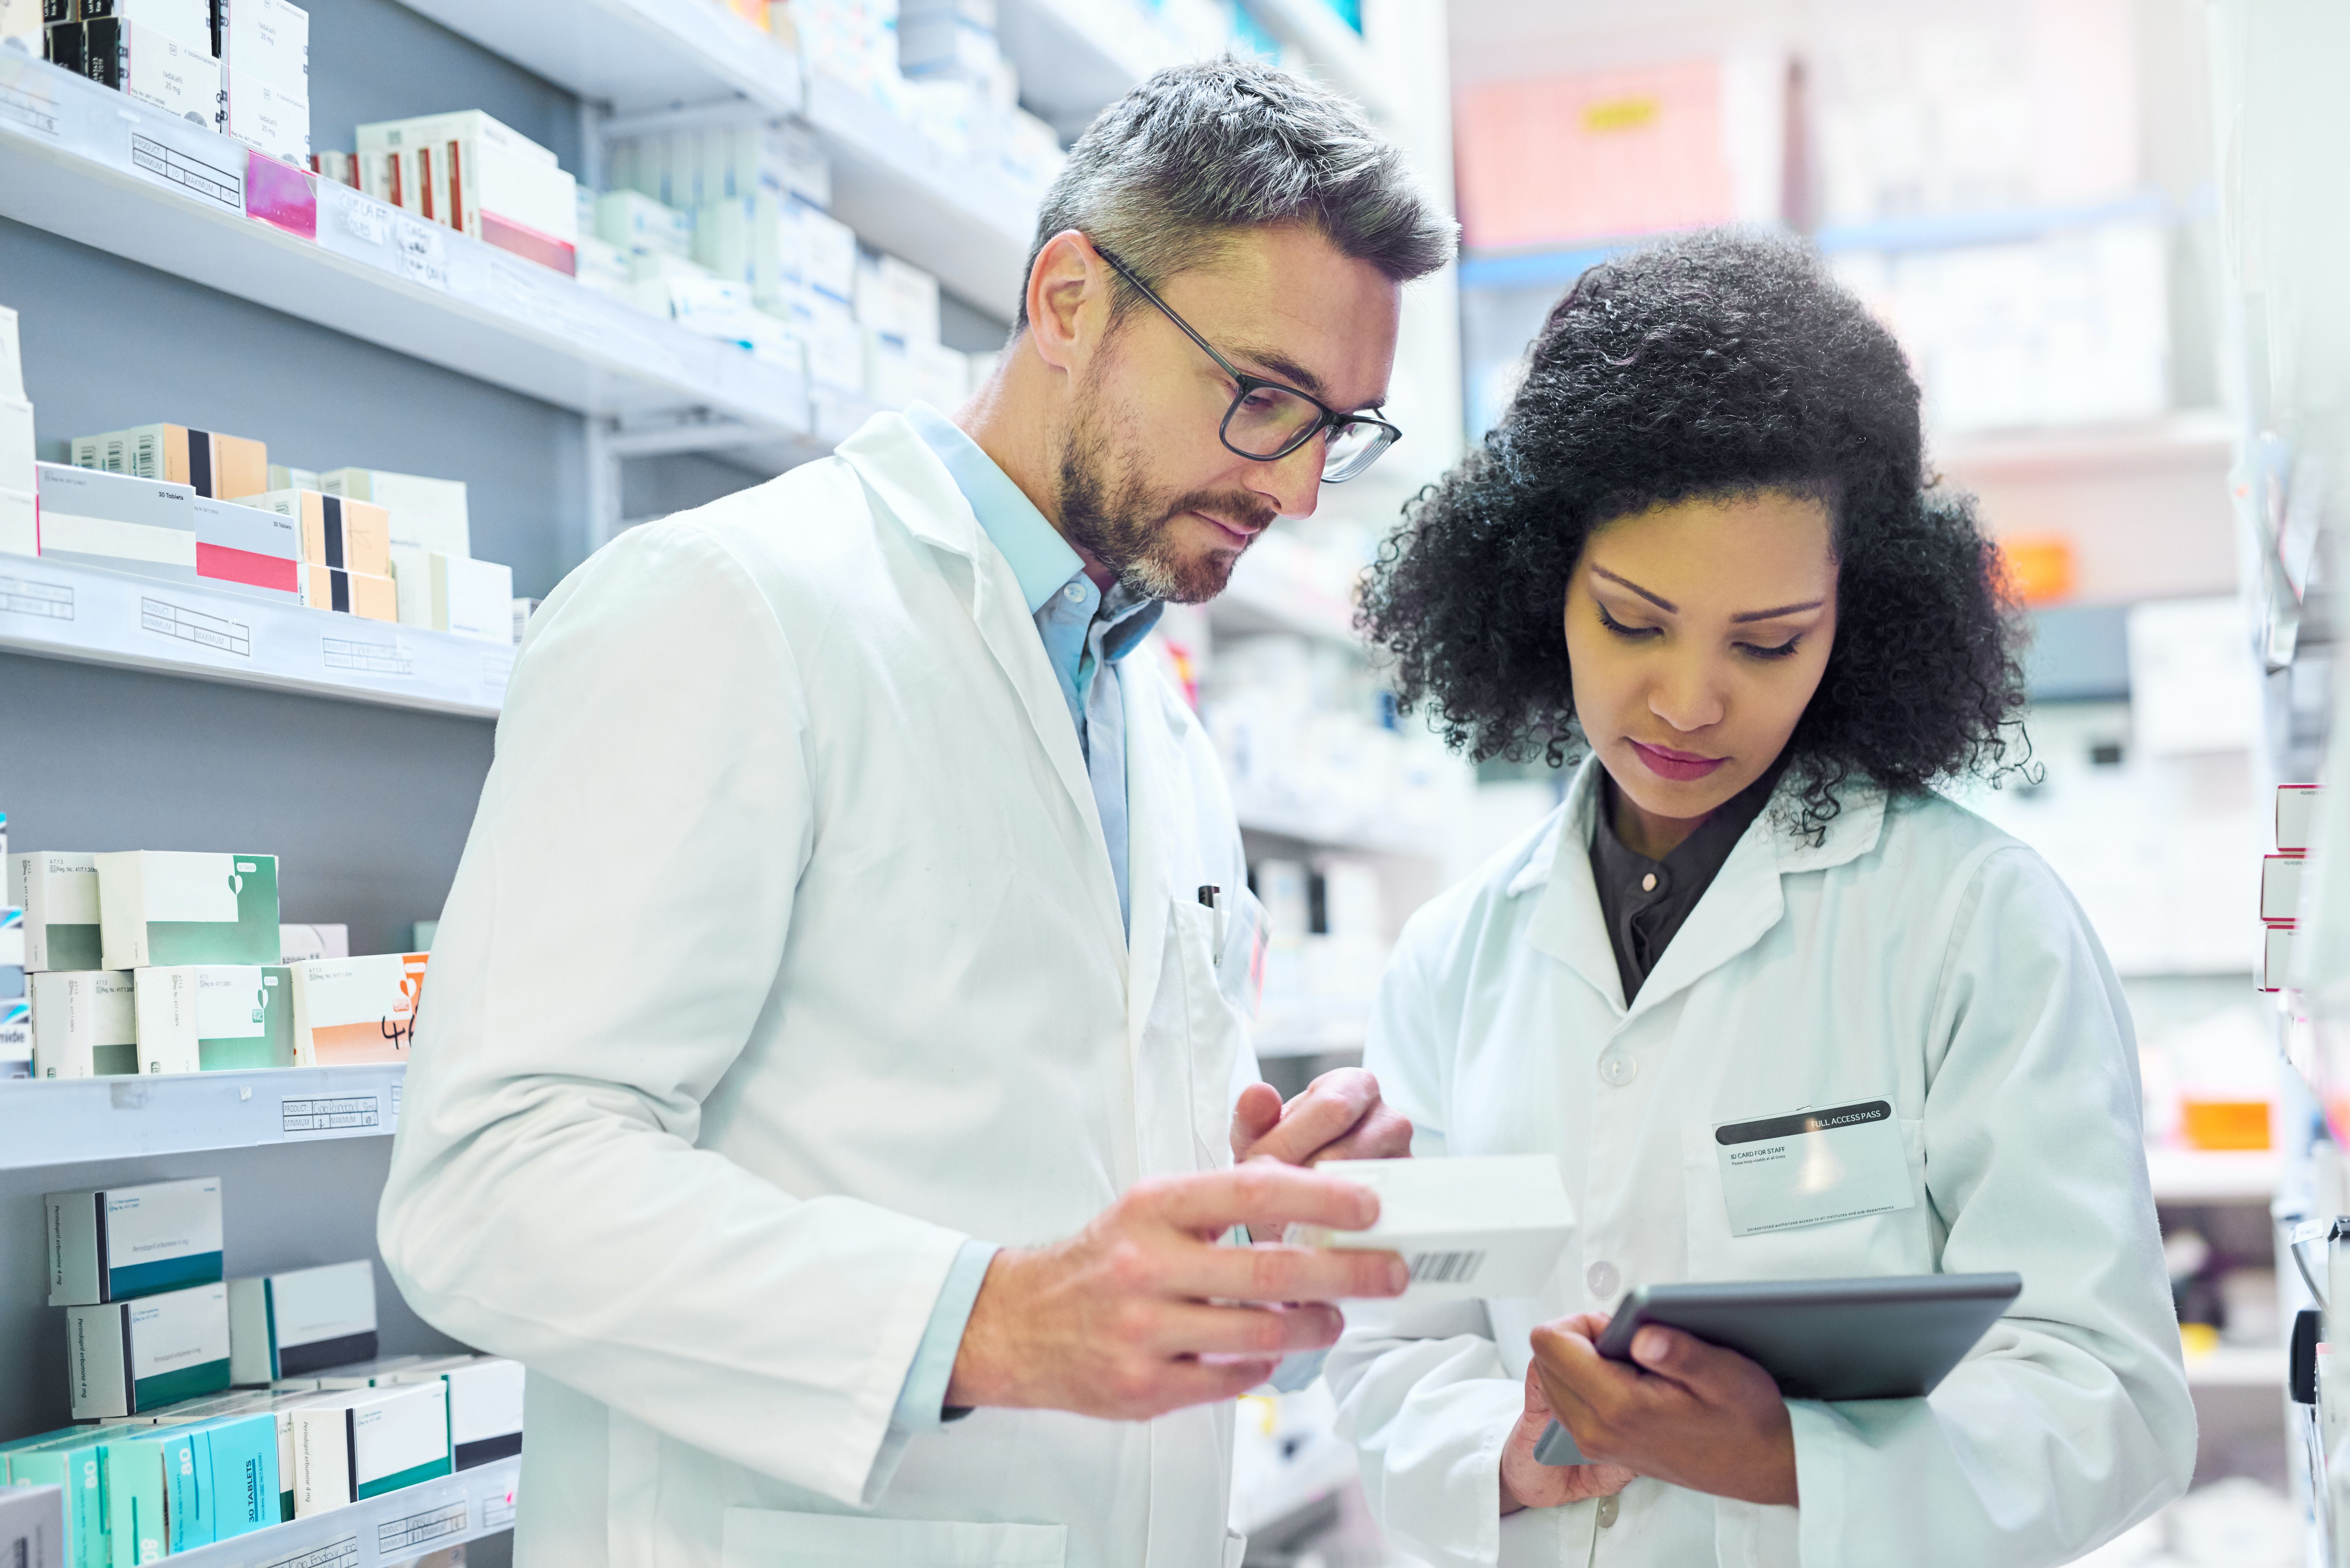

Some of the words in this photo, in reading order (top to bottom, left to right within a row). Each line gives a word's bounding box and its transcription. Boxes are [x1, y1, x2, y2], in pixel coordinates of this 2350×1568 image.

[259, 21, 276, 36] tadalafil
[267, 37, 274, 46] mg
[188, 50, 217, 68] tablets/tablette
[163, 70, 183, 85] tadalafil
[173, 86, 180, 95] mg
[259, 114, 277, 127] tadalafil
[268, 128, 275, 138] mg
[134, 138, 162, 156] PRODUCT:
[134, 152, 163, 171] MINIMUM
[186, 175, 213, 193] MAXIMUM
[143, 617, 172, 631] MINIMUM
[196, 631, 224, 645] MAXIMUM
[253, 1012, 263, 1021] 4MG
[284, 1119, 310, 1127] MINIMUM
[331, 1116, 355, 1124] MAXIMUM
[1812, 1119, 1830, 1128] FULL
[1832, 1114, 1860, 1125] ACCESS
[1861, 1110, 1881, 1120] PASS
[1857, 1205, 1894, 1215] sub-departments
[57, 1275, 62, 1285] mg
[81, 1388, 86, 1398] mg
[179, 1447, 193, 1476] 80
[305, 1492, 310, 1502] mg
[249, 1509, 254, 1523] 30
